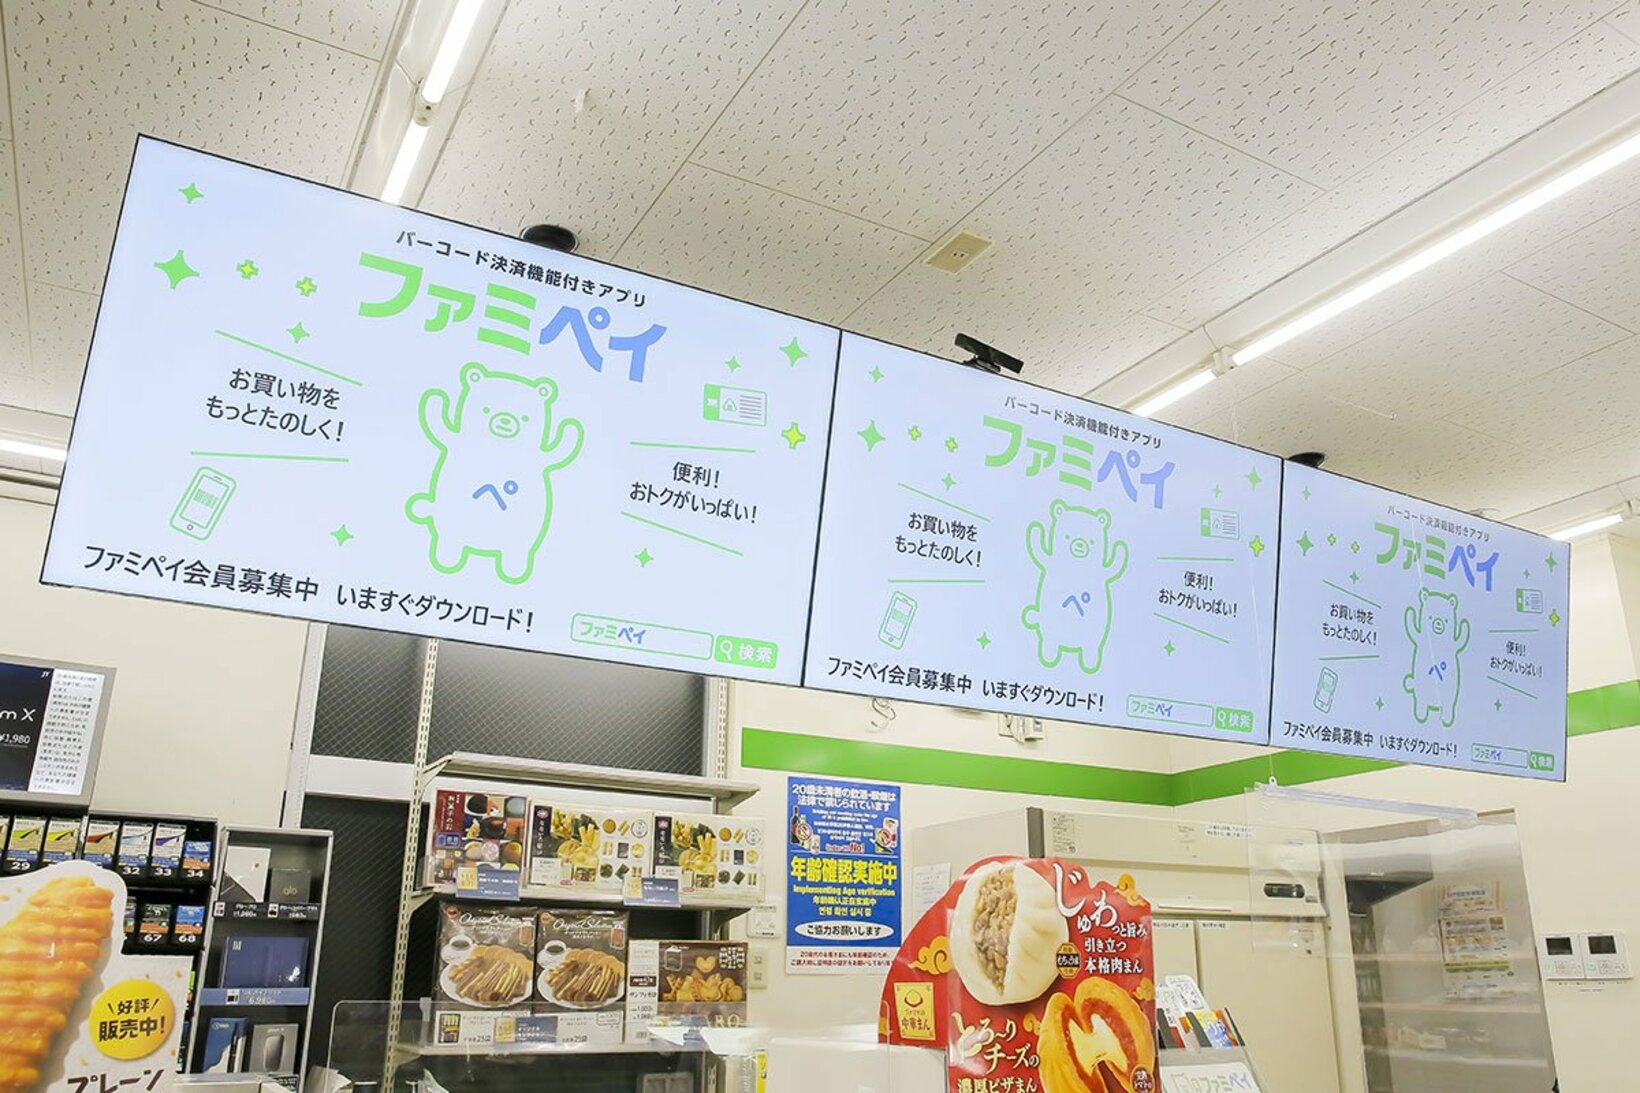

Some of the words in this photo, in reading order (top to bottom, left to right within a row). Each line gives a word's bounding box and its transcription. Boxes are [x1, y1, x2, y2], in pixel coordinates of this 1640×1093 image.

[396, 230, 647, 308] バーコード決済機能付きアプリ
[358, 252, 668, 383] ファミペイ
[229, 368, 341, 411] お買い物を
[1004, 396, 1162, 449] バーコード決済機能付きアプリ
[983, 414, 1176, 510] ファミペイ
[908, 512, 978, 542] お買い物を
[1374, 522, 1500, 592] ファミペイ
[83, 545, 319, 602] ファミペイ会員募集中
[1330, 604, 1374, 624] お買い物を
[580, 620, 647, 645] ファミペイ
[738, 643, 773, 663] 検索
[828, 656, 972, 694] ファミペイ会員募集中
[1283, 721, 1374, 747] ファミペイ会員募集中
[11, 862, 31, 871] 29
[123, 866, 140, 875] 32
[154, 867, 172, 877] 33
[186, 870, 204, 878] 34
[791, 856, 897, 886] 年齢確認実施中
[144, 934, 163, 943] 67
[178, 934, 197, 943] 68
[807, 924, 882, 936] ご協力お願いします
[1085, 937, 1127, 953] 引き立つ
[1084, 956, 1144, 974] 本格肉まん
[984, 1043, 1040, 1075] チーズの
